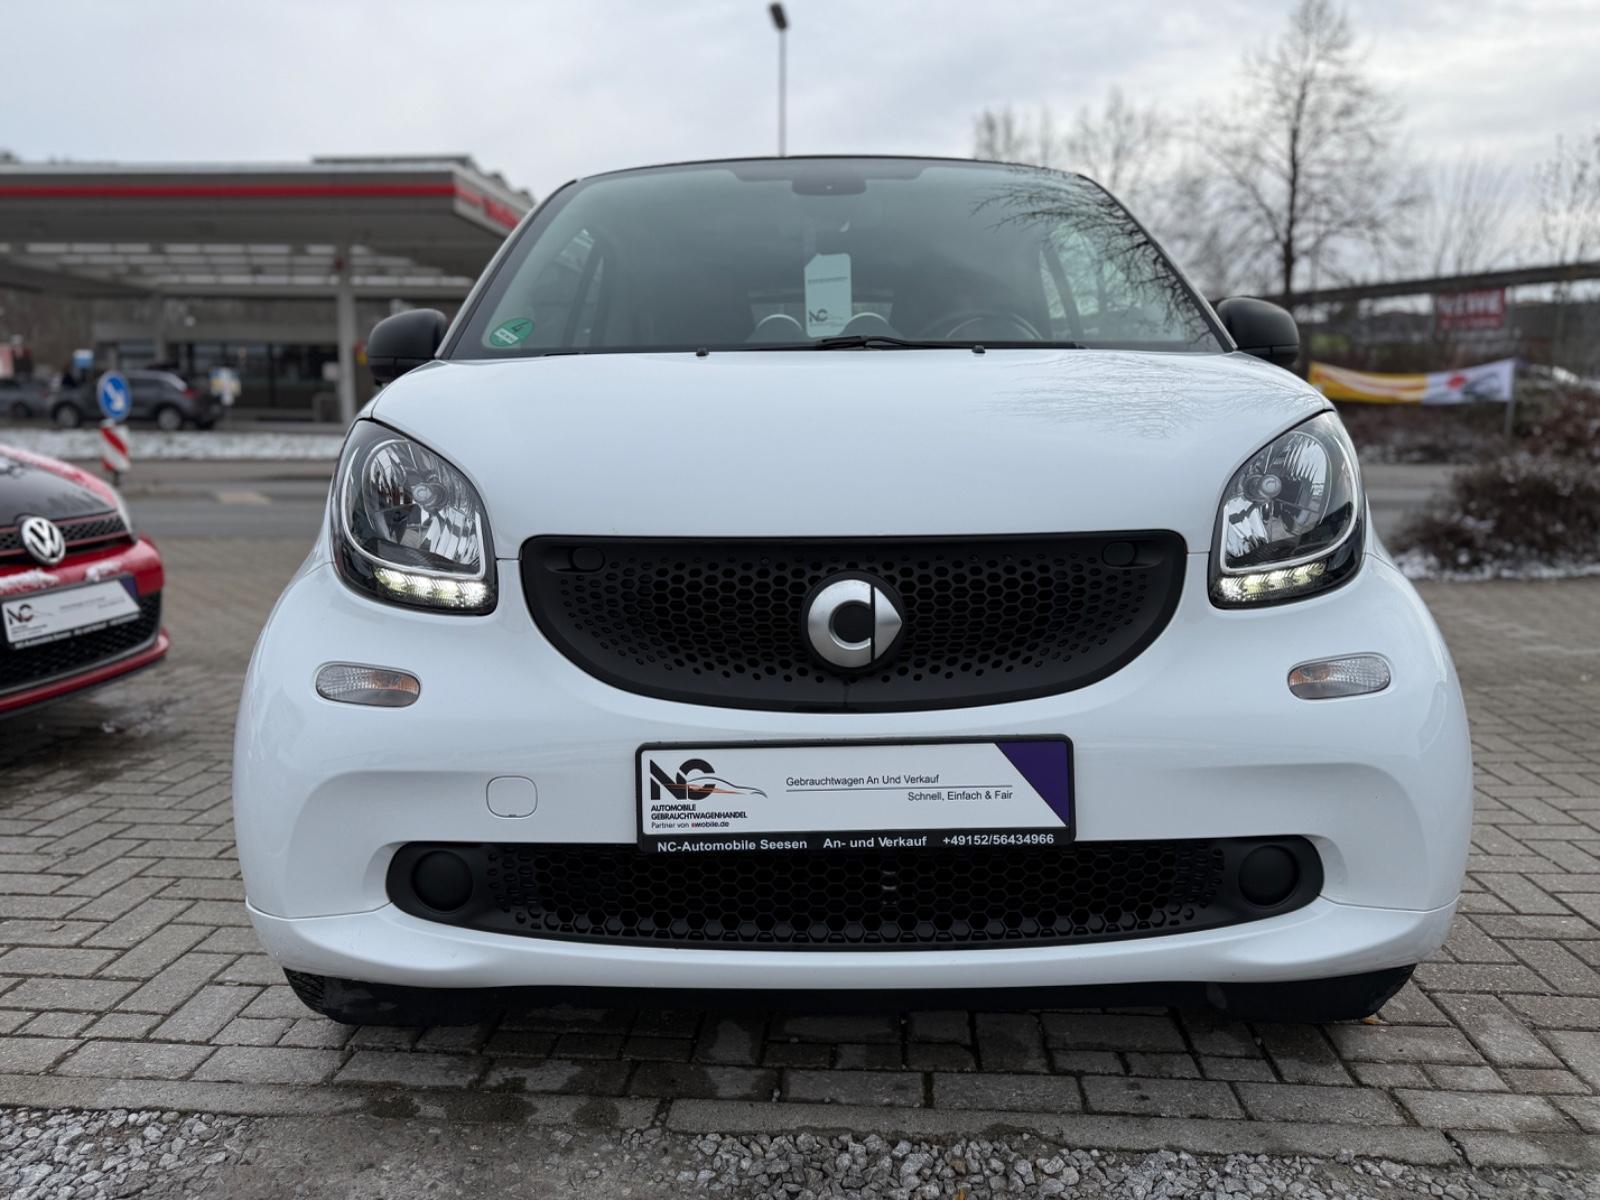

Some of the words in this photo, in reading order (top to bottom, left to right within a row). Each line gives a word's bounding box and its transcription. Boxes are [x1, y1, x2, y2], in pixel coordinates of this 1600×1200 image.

[7, 603, 34, 626] NC
[650, 758, 716, 800] NC
[786, 776, 864, 787] Gebrauchtwagen
[866, 775, 880, 785] An
[882, 775, 901, 785] Und
[903, 774, 940, 784] Verkauf
[907, 791, 945, 801] Schnell,
[947, 790, 982, 801] Einfach
[985, 790, 993, 800] &
[995, 790, 1013, 800] Fair
[651, 803, 697, 812] AUTOMOBILE
[651, 811, 748, 820] GEBRAUCHTWAGENHANDEL
[651, 821, 675, 829] Partner
[657, 840, 756, 852] NC-Automobile
[760, 839, 808, 850] Seesen
[823, 838, 847, 849] An-
[850, 837, 875, 848] und
[878, 835, 928, 847] Verkauf
[942, 833, 1055, 846] +49152/56434966
